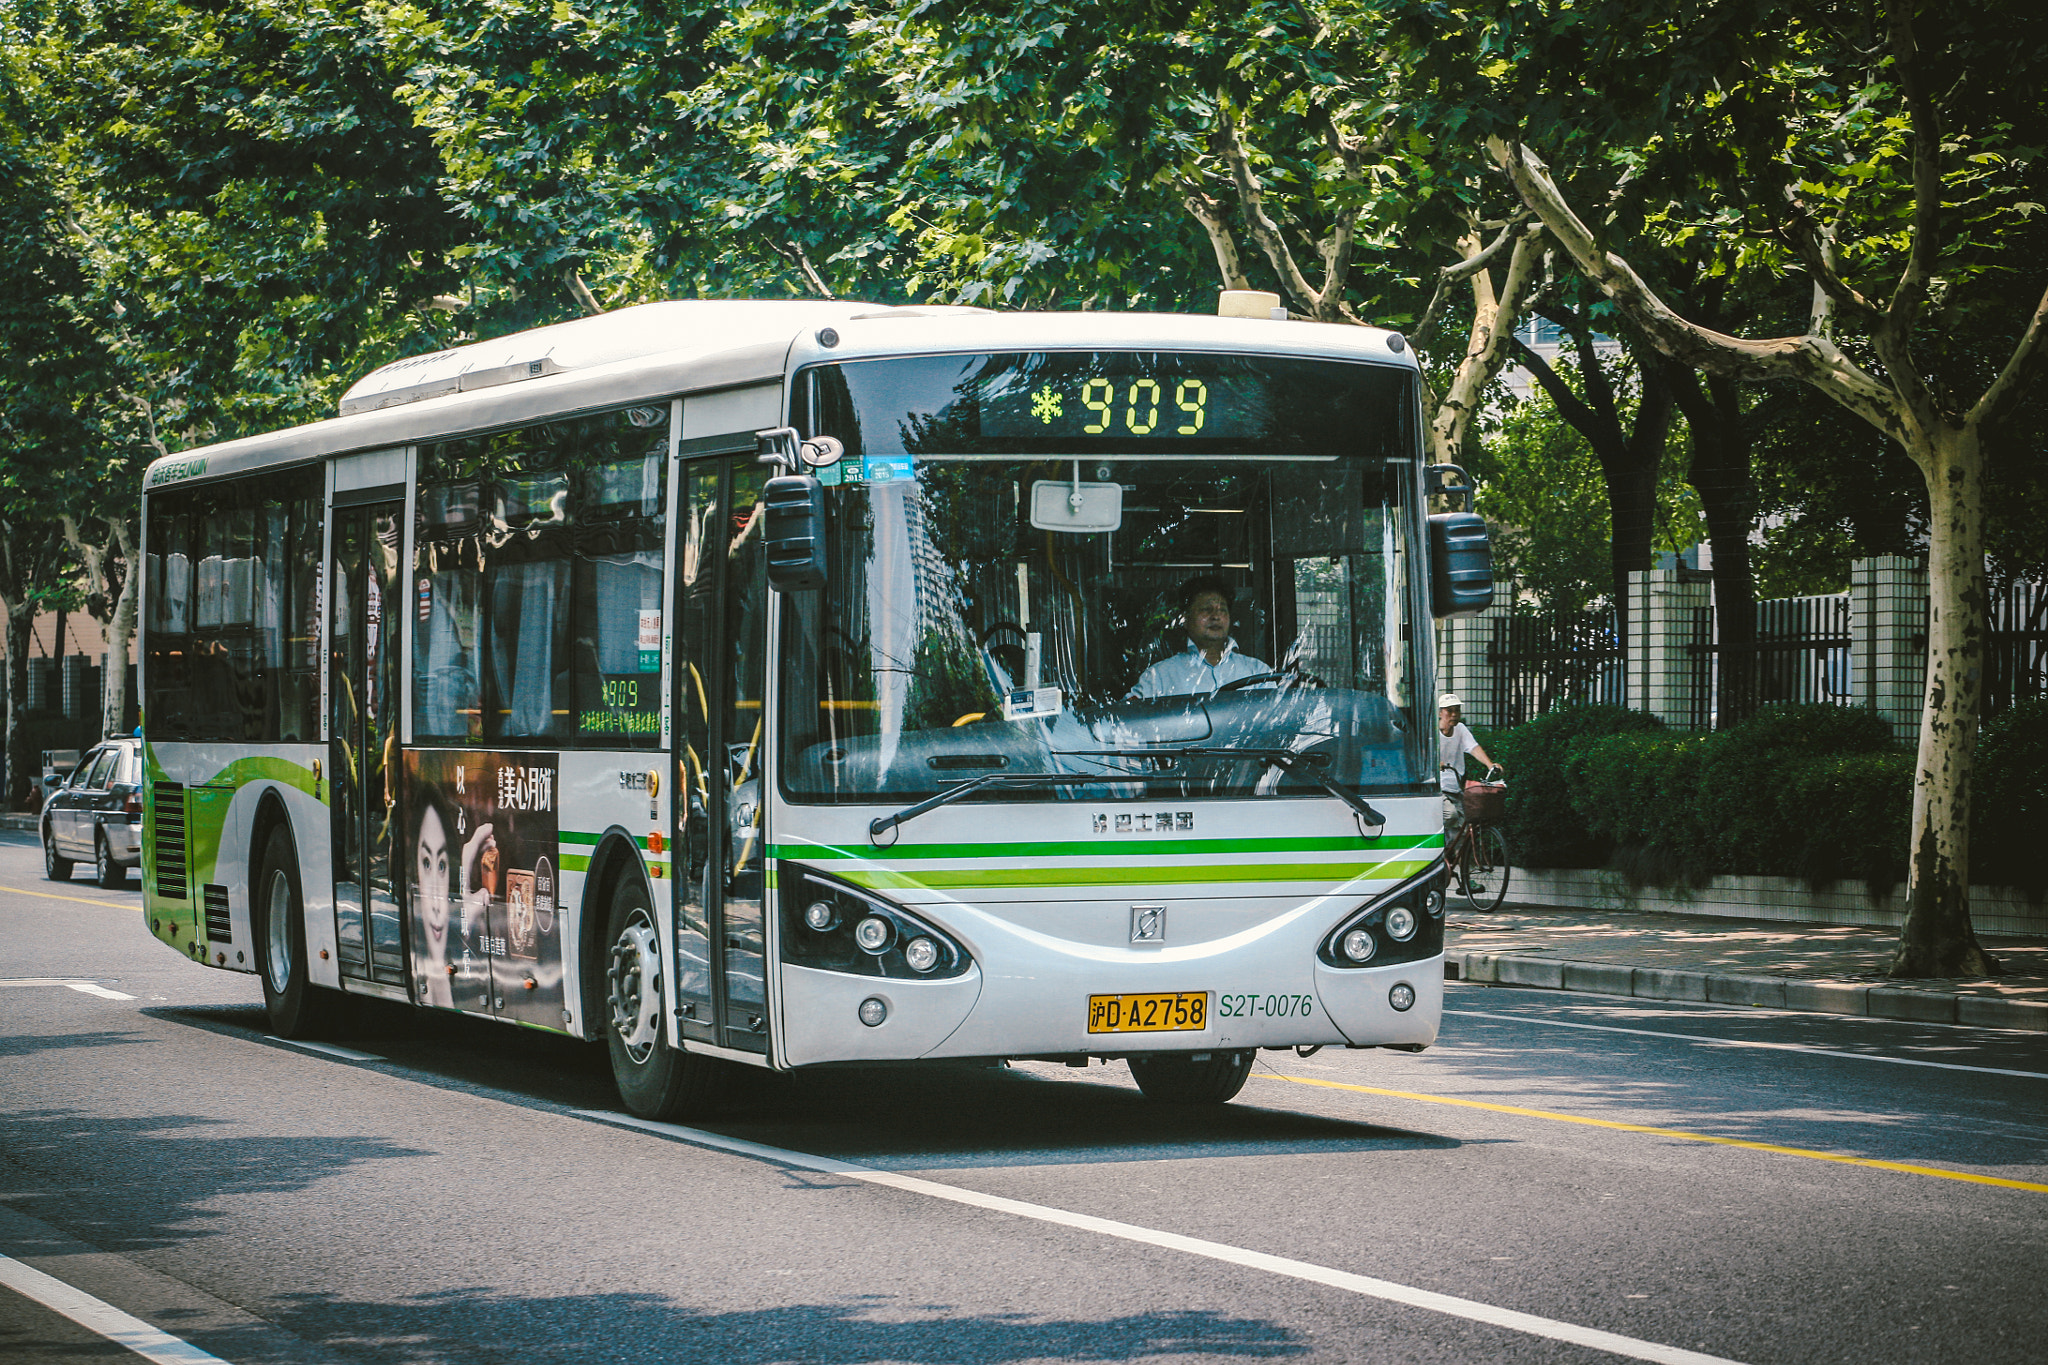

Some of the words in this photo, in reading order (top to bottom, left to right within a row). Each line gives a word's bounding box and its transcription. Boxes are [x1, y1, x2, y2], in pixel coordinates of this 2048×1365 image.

[1081, 378, 1207, 435] 909
[845, 474, 864, 482] 2015
[609, 680, 638, 707] 909
[504, 766, 552, 812] 美心月饼
[1115, 811, 1194, 832] 巴士集团
[1219, 994, 1312, 1018] S2T-0076
